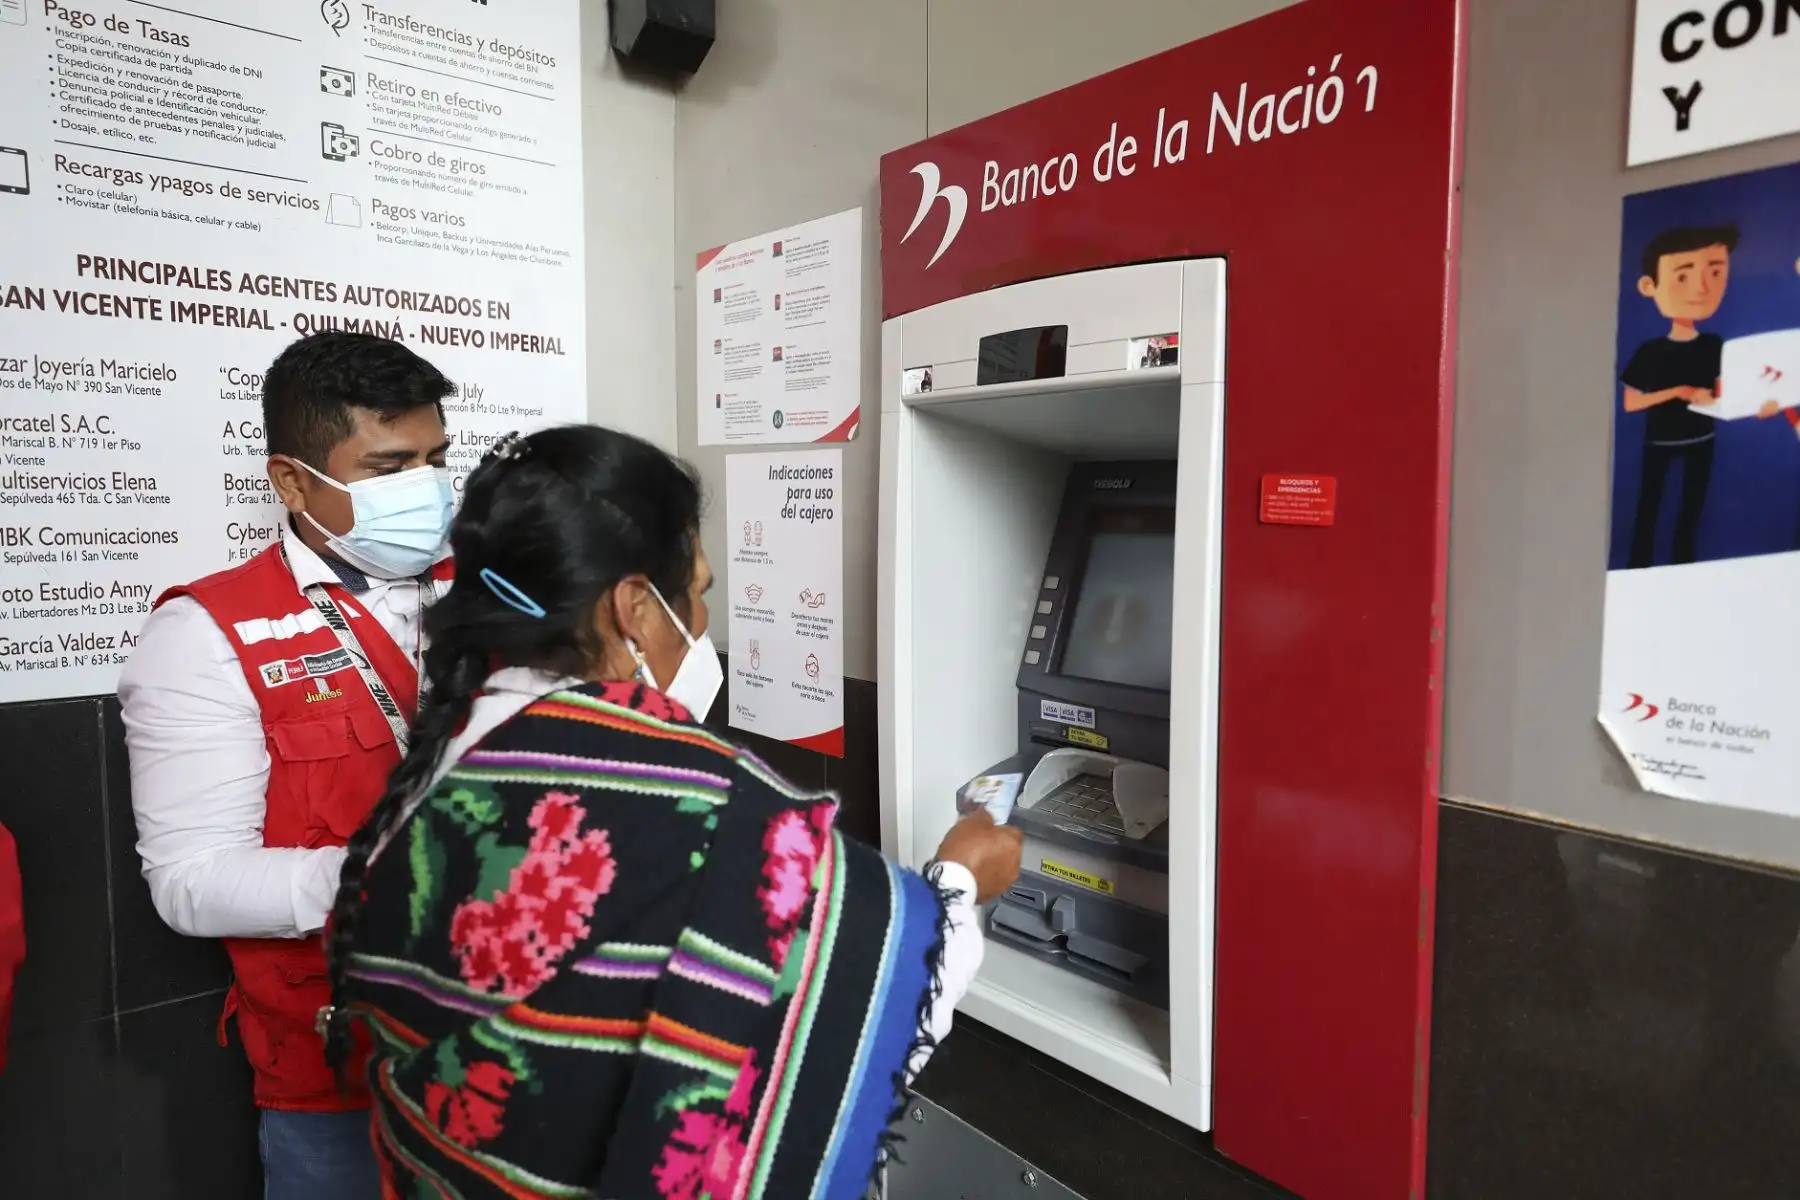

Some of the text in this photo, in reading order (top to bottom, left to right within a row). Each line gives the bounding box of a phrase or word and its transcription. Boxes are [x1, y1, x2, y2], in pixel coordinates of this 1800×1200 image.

[44, 0, 190, 48] Pago de Tasas
[362, 3, 556, 68] Transferencias y depósitos
[55, 26, 262, 79] Inscripción, renovación y duplicado de DNI
[56, 39, 193, 75] Copia certificada de partida
[57, 54, 243, 100] Expedición y renovación de pasaporte.
[58, 66, 100, 83] Licencia
[102, 76, 115, 86] de
[118, 81, 161, 94] conducir
[163, 90, 169, 98] y
[206, 97, 218, 106] de
[221, 101, 267, 116] conductor.
[59, 78, 108, 96] Denuncia
[111, 91, 145, 103] policial
[368, 73, 502, 116] Retiro en efectivo
[60, 91, 286, 141] Certificado de antecedentes penales y judiciales,
[1662, 80, 1703, 131] Y
[60, 105, 276, 149] ofrecimiento de pruebas y notificación judicial
[61, 118, 156, 144] Dosaje, etílico, etc.
[370, 140, 486, 175] Cobro de giros
[981, 152, 1078, 212] Banco
[1092, 122, 1138, 182] de
[1153, 107, 1189, 168] la
[55, 154, 143, 187] Recargas
[220, 181, 241, 199] de
[248, 189, 319, 211] servicios
[65, 184, 137, 205] Claro (celular)
[66, 196, 261, 232] Movistar (telefonía básica, celular y cable)
[372, 198, 465, 227] Pagos varios
[77, 254, 510, 320] PRINCIPALES AGENTES AUTORIZADOS EN
[0, 286, 45, 311] AN
[53, 289, 163, 321] VICENTE
[170, 301, 275, 331] IMPERIAL
[421, 324, 485, 348] NUEVO
[491, 331, 565, 355] IMPERIAL
[33, 354, 95, 380] Joyería
[101, 359, 176, 382] Maricielo
[18, 378, 31, 389] de
[35, 379, 63, 394] Mayo
[84, 382, 103, 393] 390
[105, 383, 122, 394] San
[125, 384, 161, 396] Vicente
[462, 382, 484, 403] July
[61, 414, 115, 435] S.A.C.
[223, 420, 236, 439] A
[2, 435, 45, 448] Mariscal
[49, 437, 59, 448] B.
[80, 438, 98, 449] 719
[121, 439, 141, 450] Piso
[5, 454, 45, 466] Vicente
[3, 470, 157, 490] ultiservicios Elena
[224, 472, 270, 491] Botica
[768, 465, 834, 480] Indicaciones
[0, 492, 54, 507] Sepúlveda
[56, 493, 75, 504] 465
[104, 493, 112, 504] C
[115, 493, 132, 504] San
[135, 493, 170, 504] Vicente
[786, 486, 834, 503] para uso
[780, 503, 834, 524] del cajero
[0, 527, 178, 546] BK Comunicaciones
[226, 522, 273, 545] Cyber
[4, 550, 138, 566] Sepúlveda 161 San Vicente
[2, 580, 152, 603] oto Estudio Anny
[13, 603, 148, 619] Libertadores Mz D3 Lte 3b
[314, 600, 349, 631] NIKE
[58, 632, 115, 651] Valdez
[16, 658, 58, 671] Mariscal
[61, 657, 71, 668] B.
[92, 654, 109, 665] 634
[368, 683, 401, 717] NIKE
[1667, 697, 1717, 716] Banco
[1665, 716, 1771, 740] de la Nación
